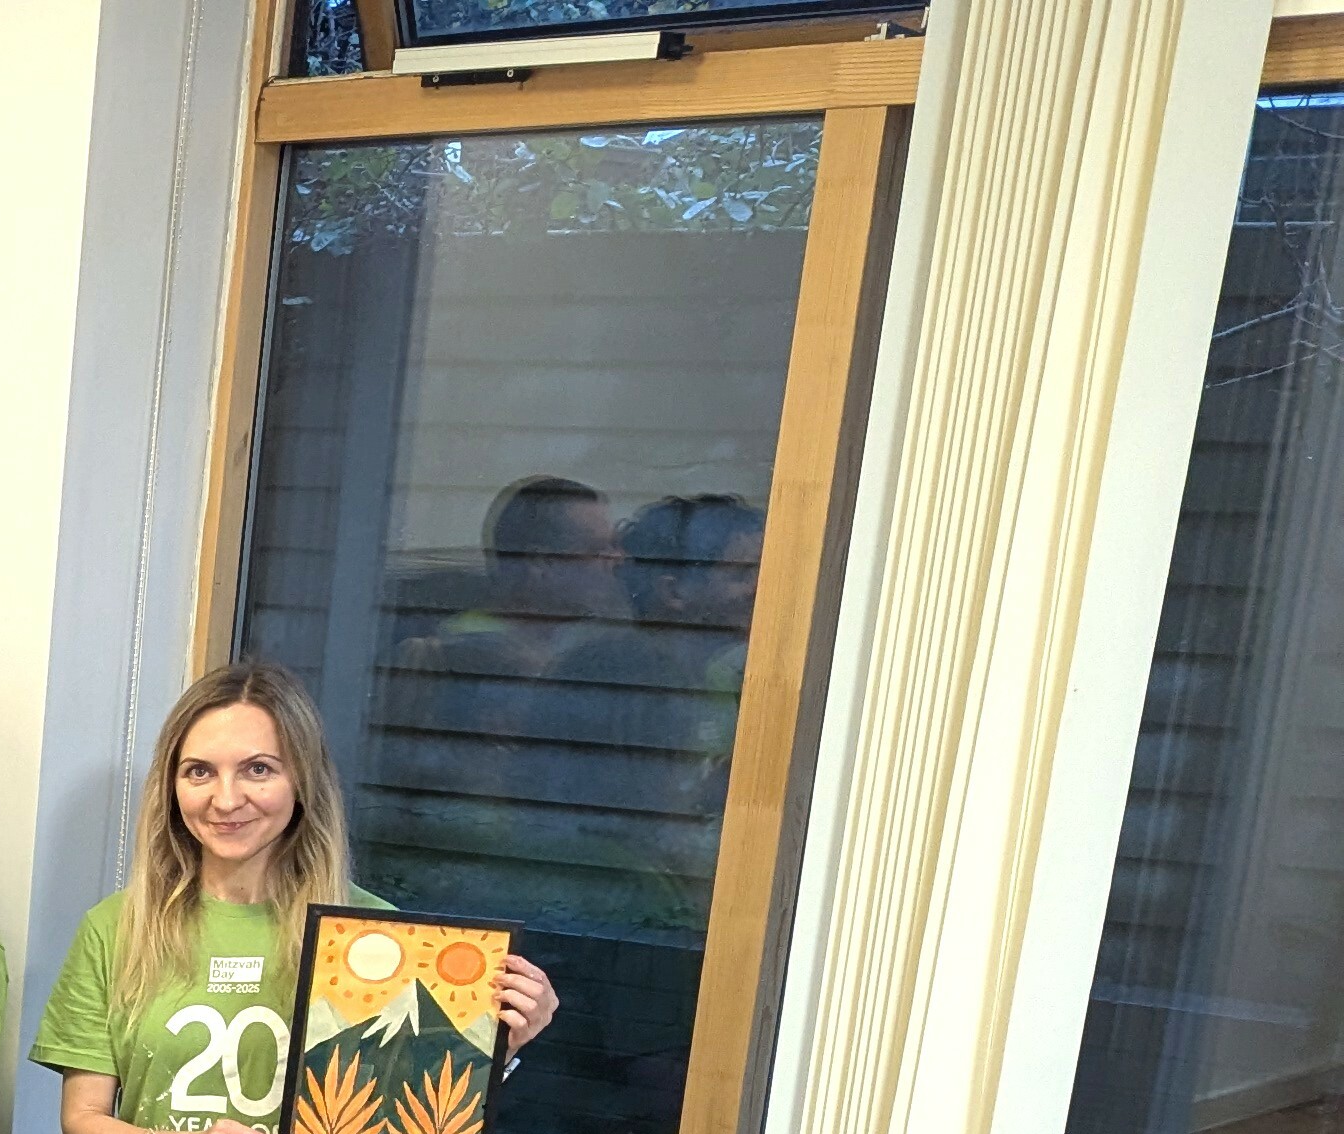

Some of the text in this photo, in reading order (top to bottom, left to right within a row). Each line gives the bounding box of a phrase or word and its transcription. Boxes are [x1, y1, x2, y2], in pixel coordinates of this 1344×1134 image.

[213, 959, 261, 969] Mitzvah
[212, 969, 235, 980] Day
[206, 983, 261, 994] 2005-2025
[165, 1004, 291, 1117] 20
